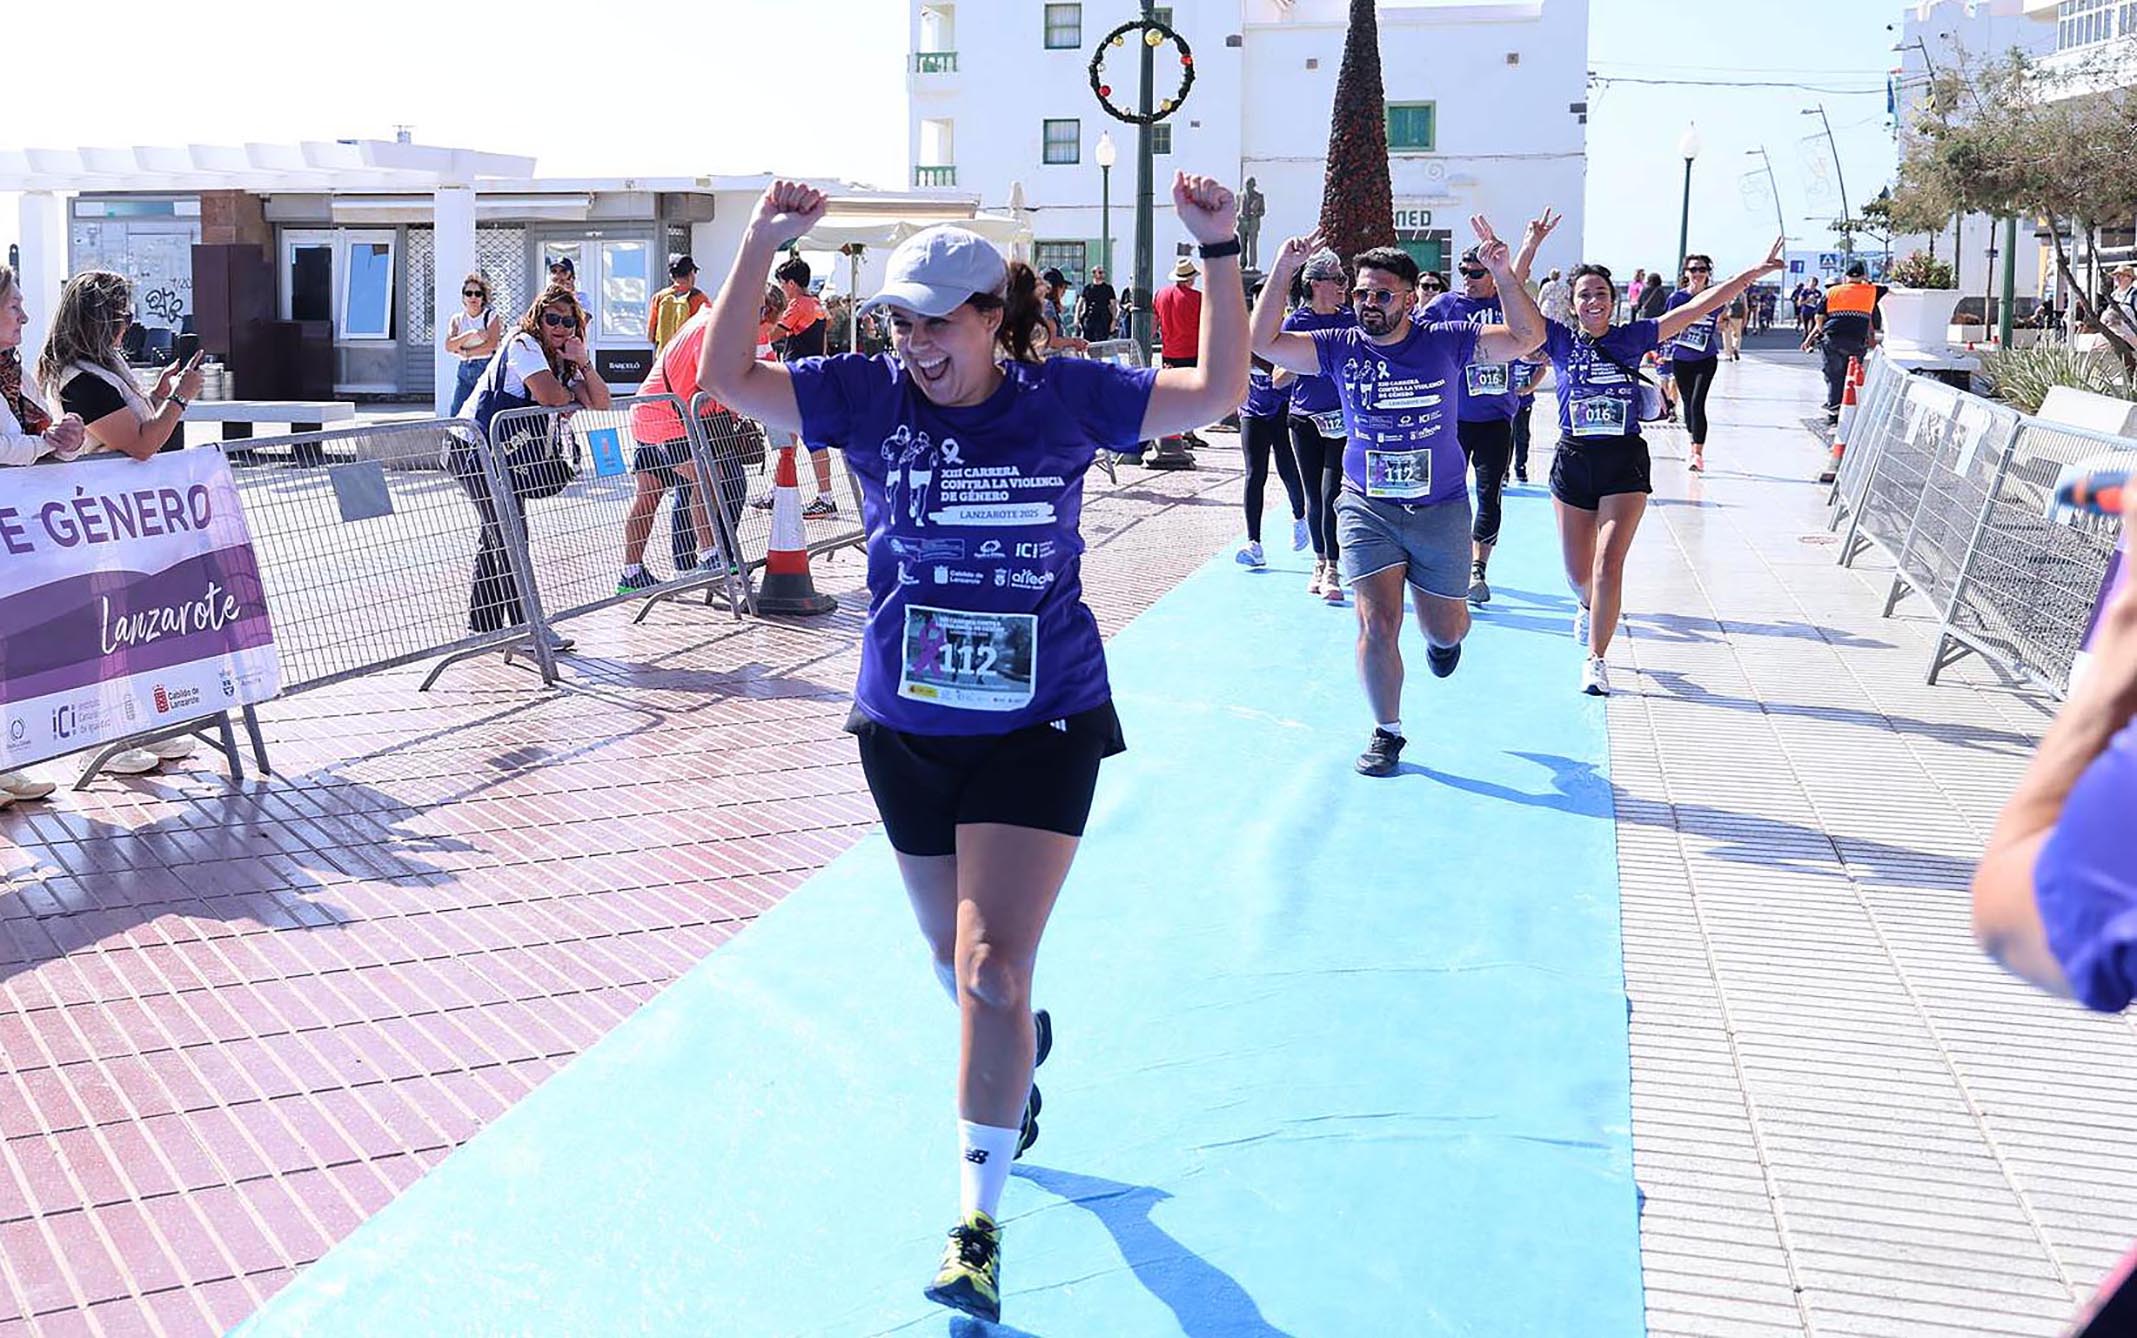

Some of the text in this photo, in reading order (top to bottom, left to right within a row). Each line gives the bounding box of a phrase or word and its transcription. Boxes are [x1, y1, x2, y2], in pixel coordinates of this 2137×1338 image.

[1395, 210, 1431, 227] NED
[1480, 373, 1499, 385] 016
[1586, 408, 1611, 421] 016
[964, 466, 1020, 477] CARRERA
[1385, 467, 1414, 482] 112
[940, 476, 1065, 490] CONTRA LA VIOLENCIA
[940, 489, 1009, 502] DE GÉNERO
[0, 484, 212, 554] E GÉNERO
[960, 509, 1016, 519] LANZAROTE
[101, 582, 241, 654] Lanzarote
[939, 643, 998, 676] 112
